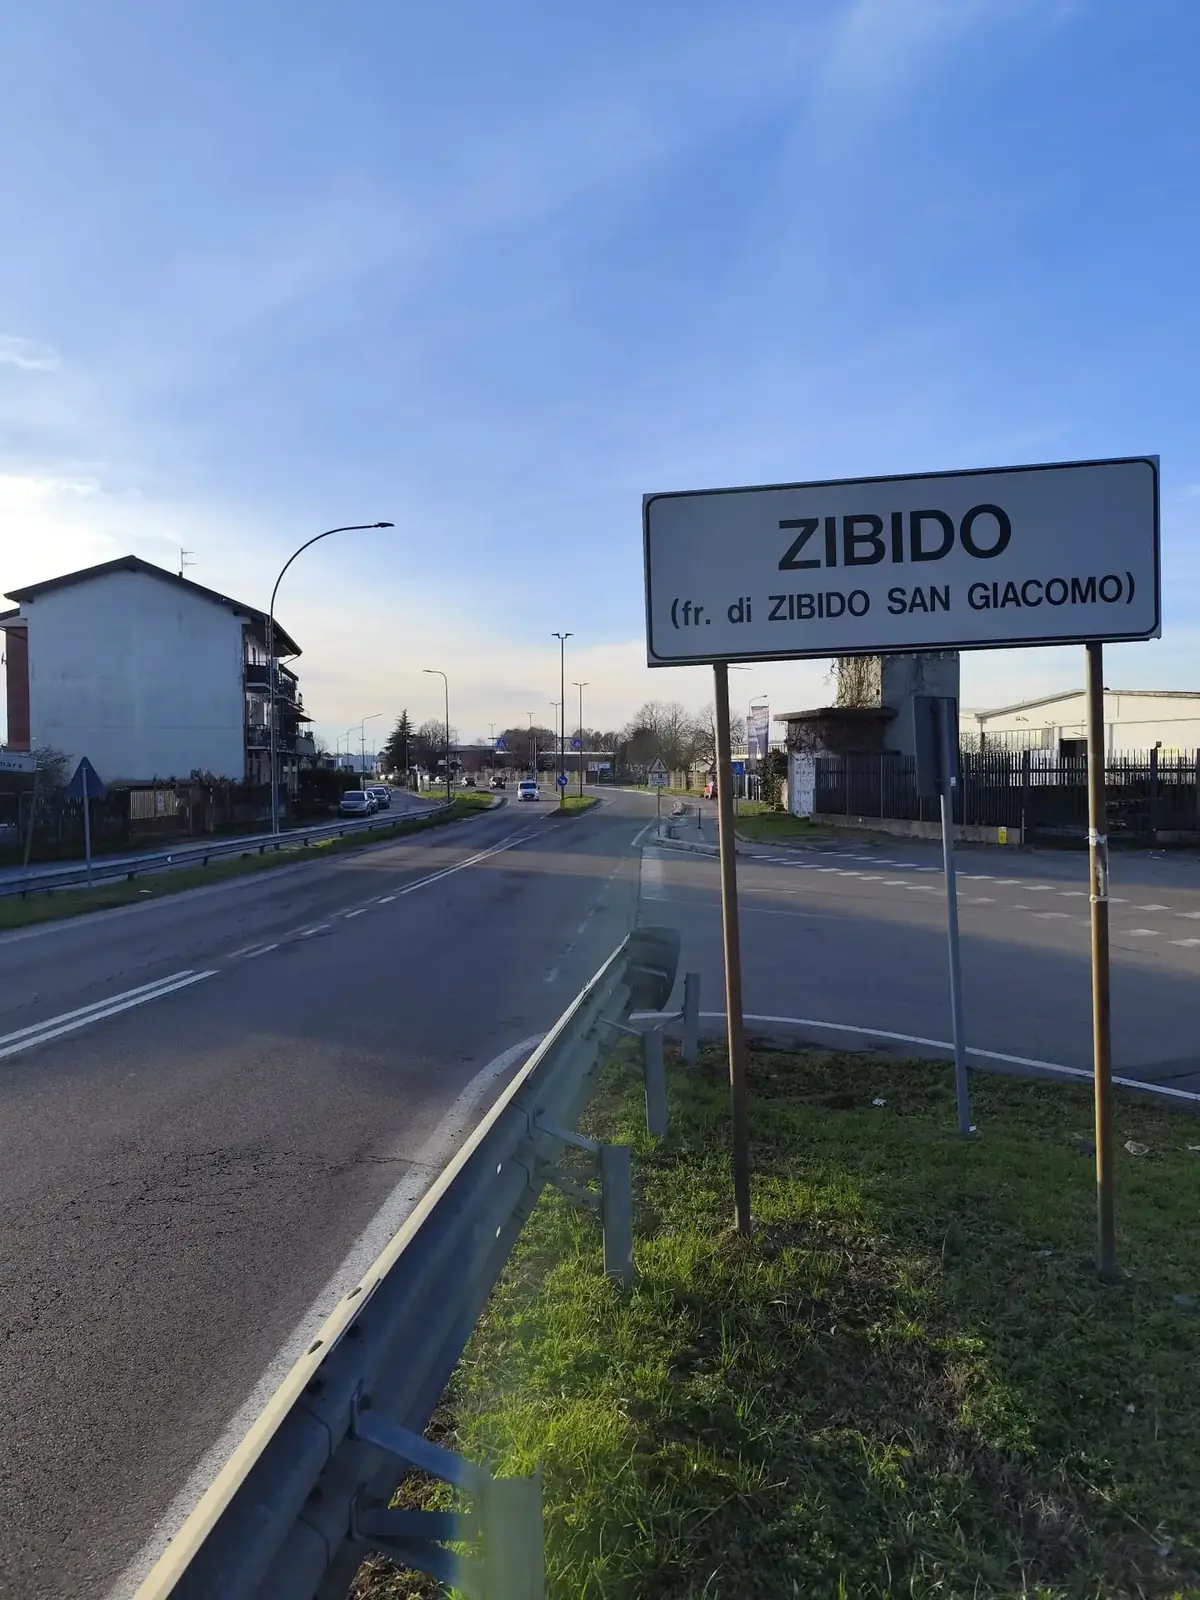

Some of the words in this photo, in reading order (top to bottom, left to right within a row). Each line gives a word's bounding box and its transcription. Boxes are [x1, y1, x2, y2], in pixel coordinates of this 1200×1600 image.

[778, 503, 1012, 571] ZIBIDO
[670, 598, 711, 629] (fr.
[727, 597, 752, 624] di
[767, 589, 871, 622] ZIBIDO
[887, 585, 951, 615] SAN
[967, 571, 1136, 611] GIACOMO)
